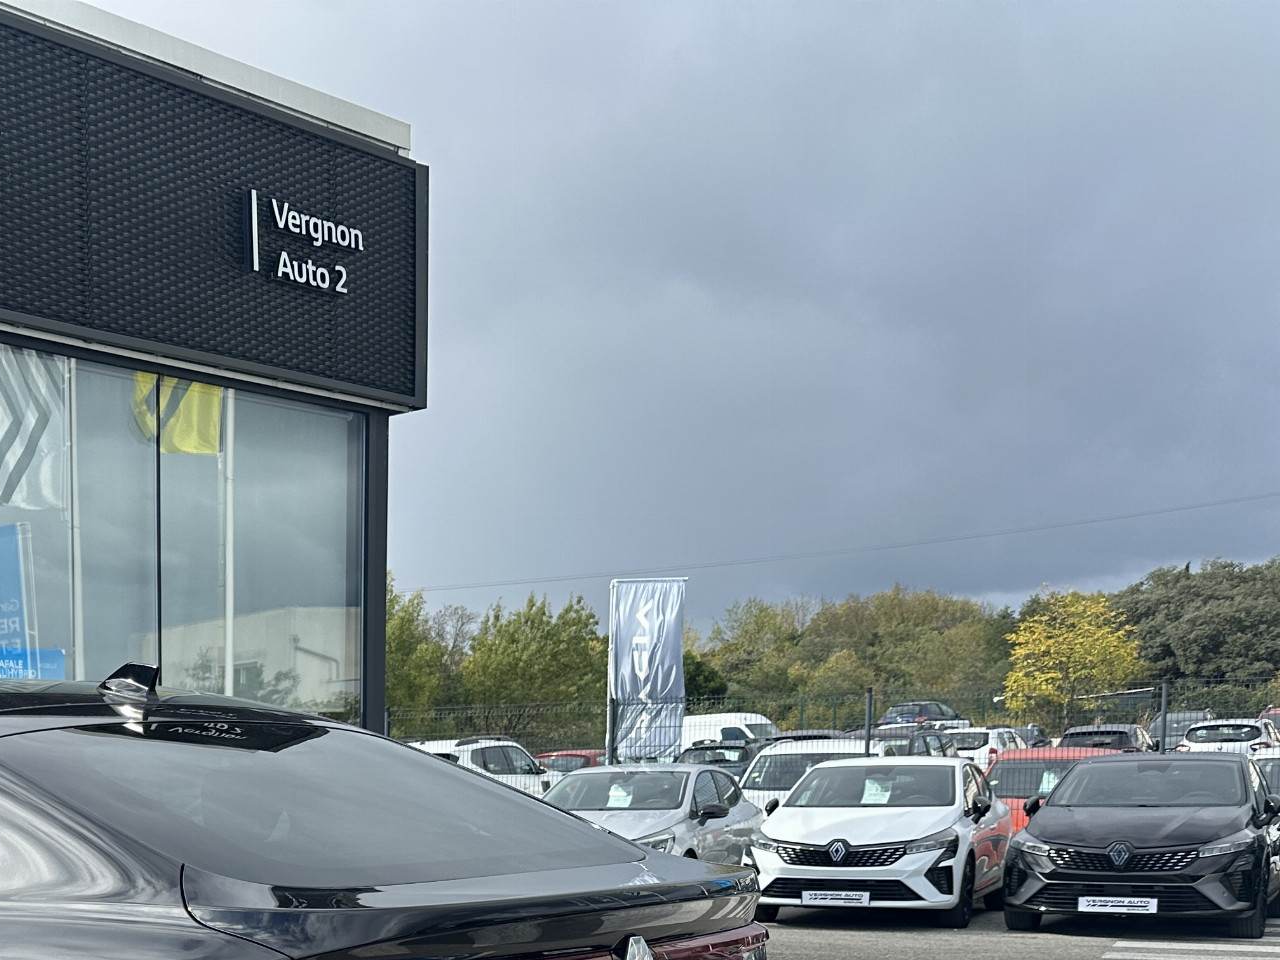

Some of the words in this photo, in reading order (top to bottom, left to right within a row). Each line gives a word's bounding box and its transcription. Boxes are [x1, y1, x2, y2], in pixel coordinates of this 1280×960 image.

[271, 198, 364, 251] Vergnon
[277, 251, 330, 289] Auto
[334, 265, 348, 294] 2
